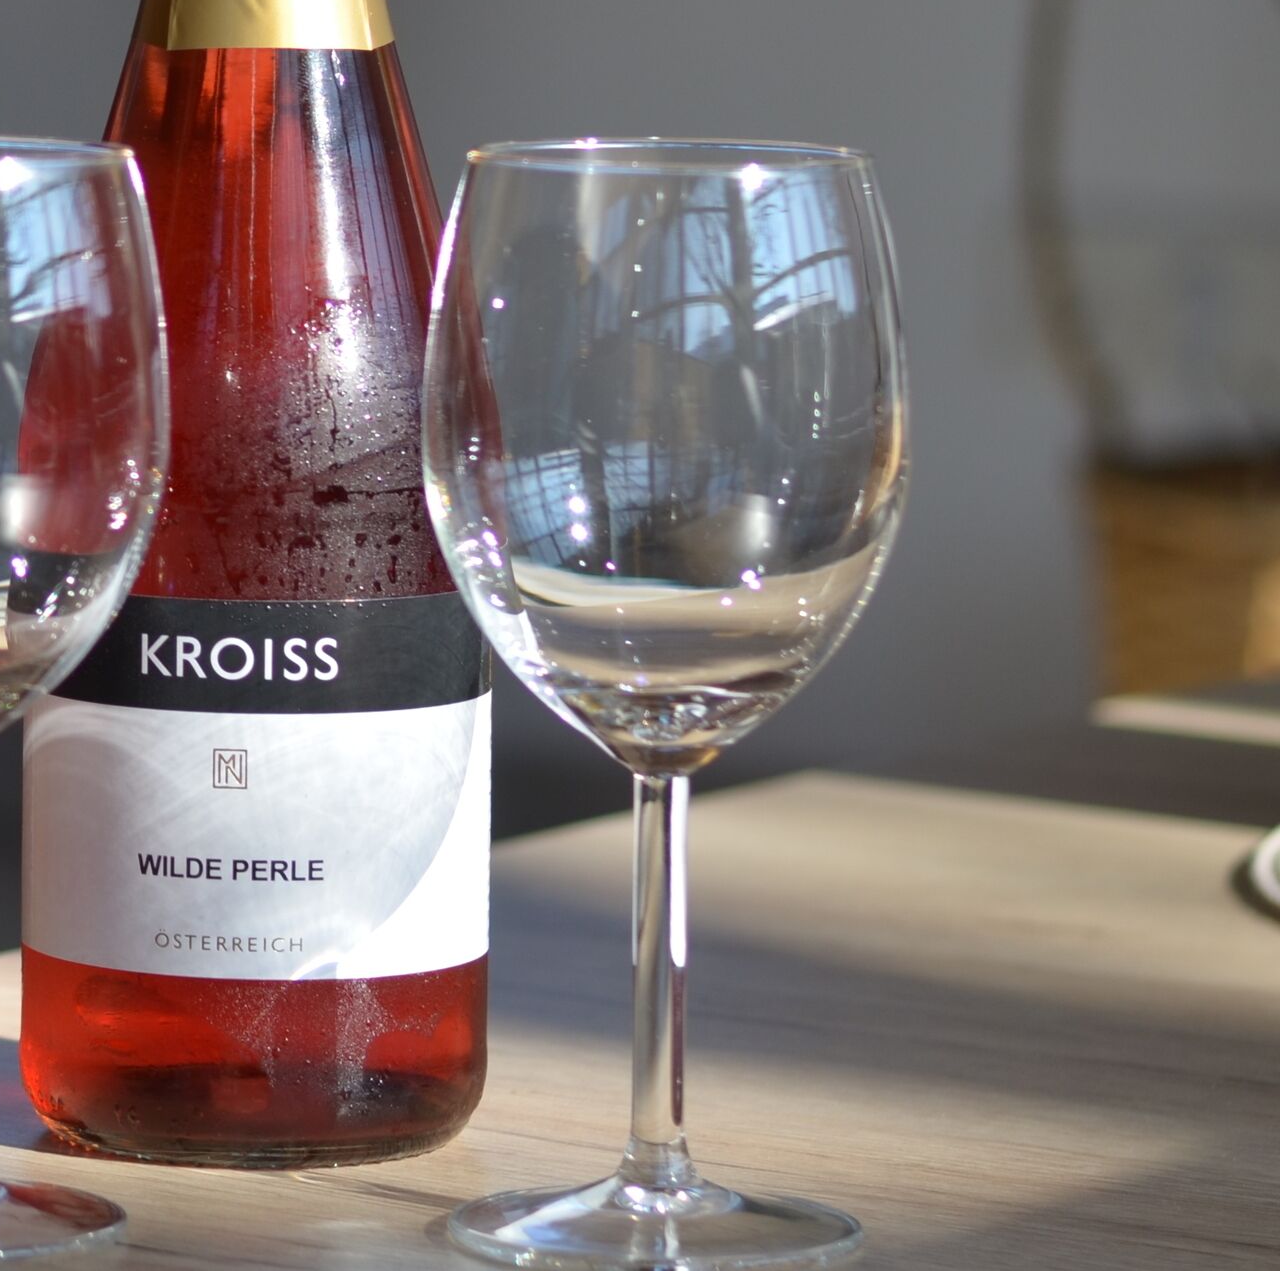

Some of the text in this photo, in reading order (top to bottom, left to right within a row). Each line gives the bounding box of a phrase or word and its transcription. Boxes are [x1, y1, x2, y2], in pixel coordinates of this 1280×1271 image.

[141, 633, 339, 681] KROISS
[137, 853, 325, 881] WILDE PERLE
[154, 929, 304, 953] ÖSTERREICH
